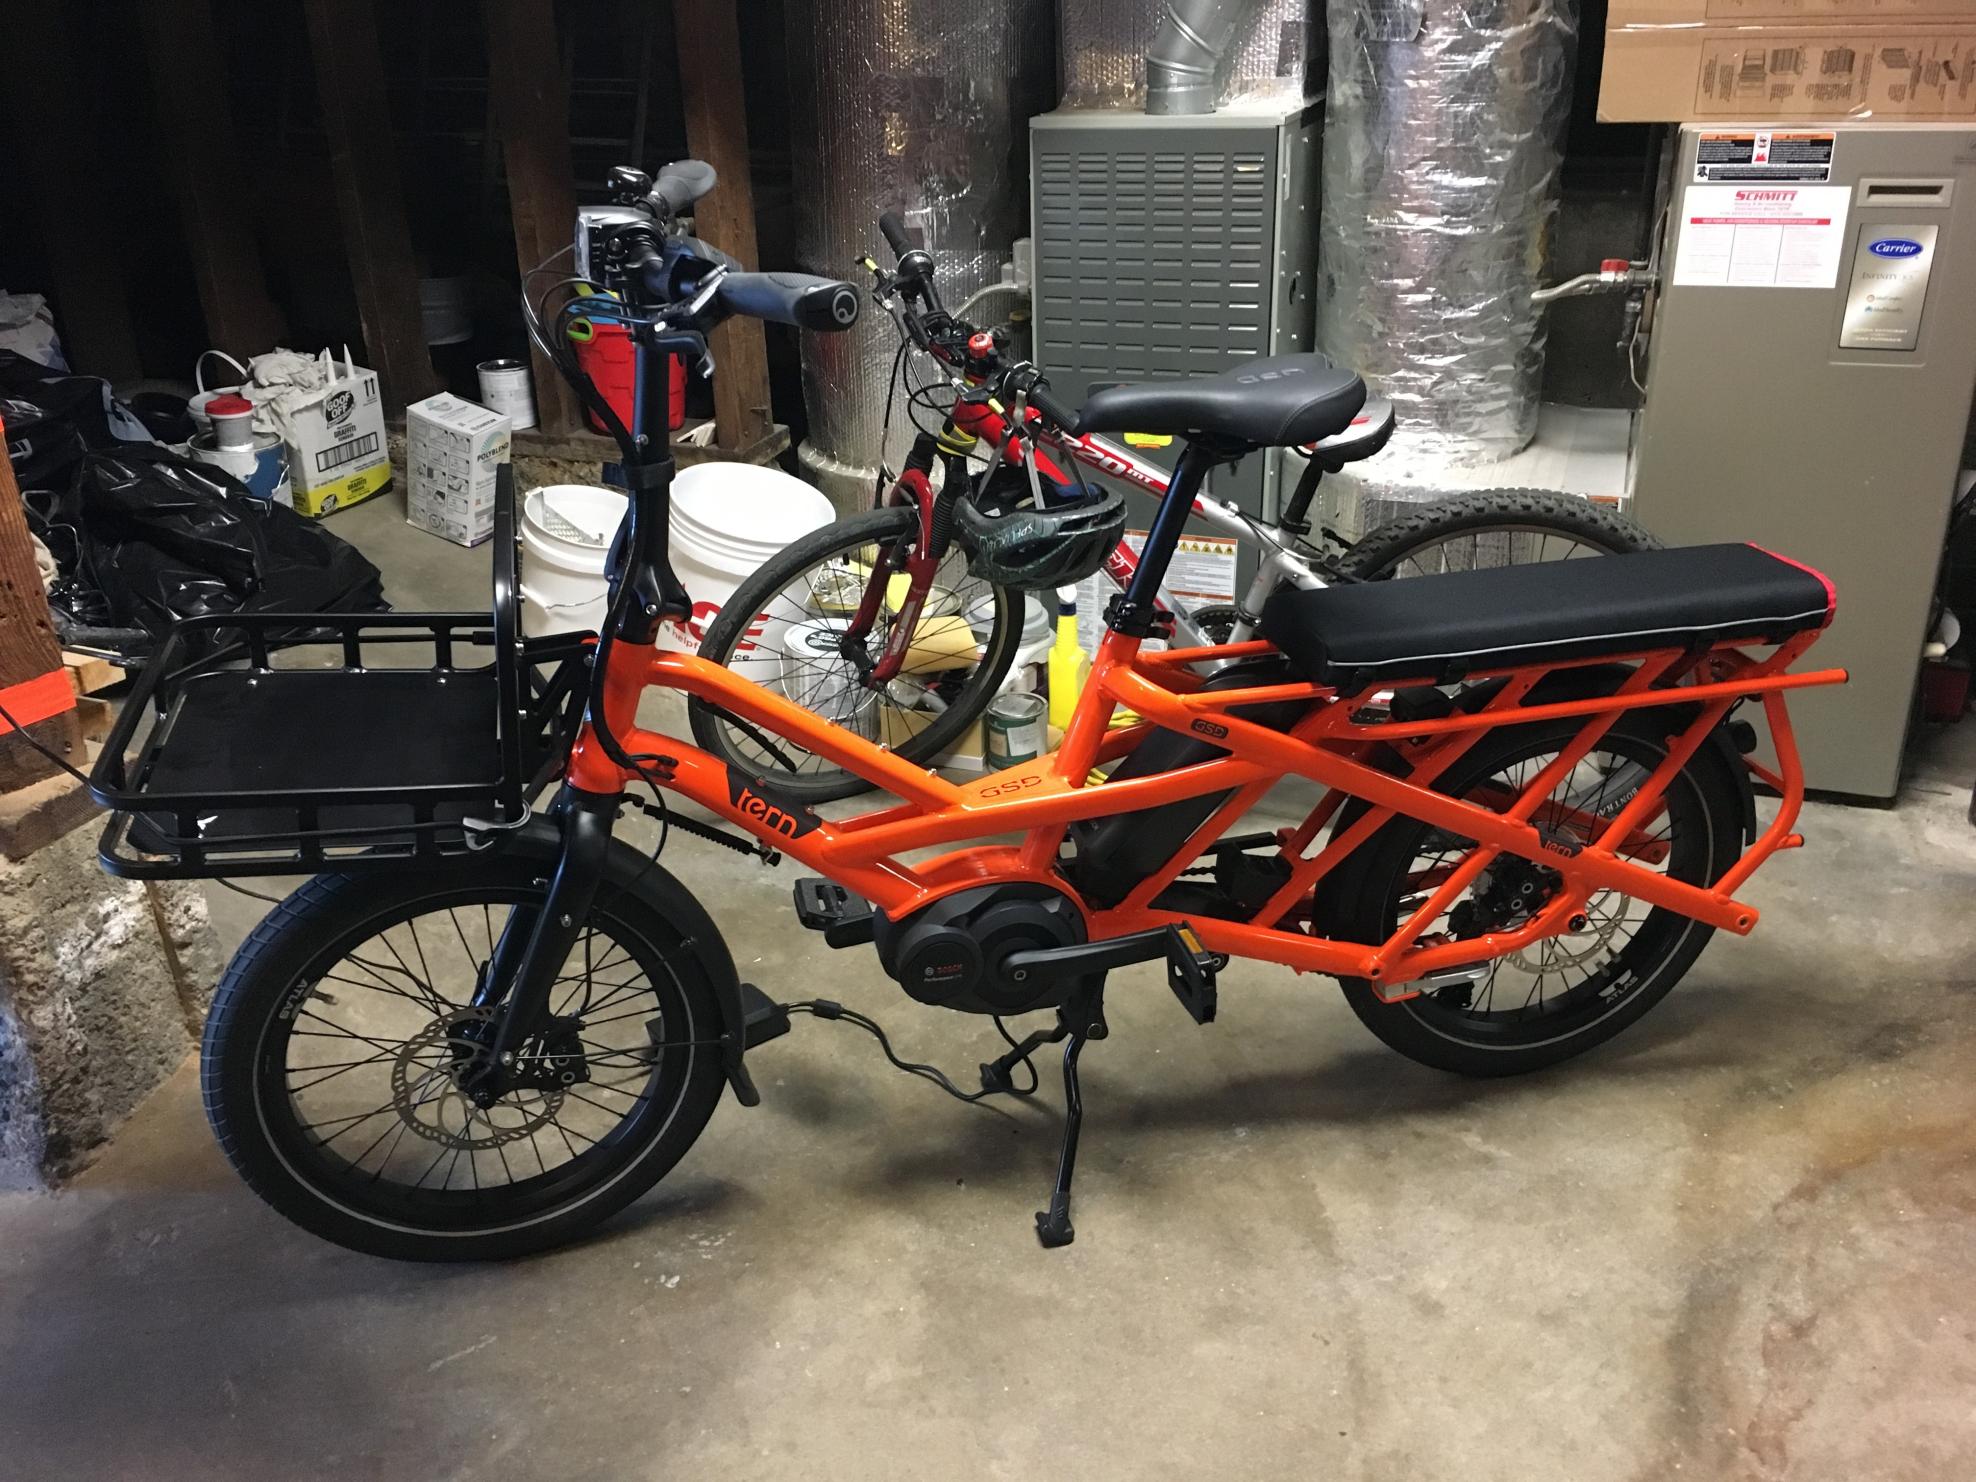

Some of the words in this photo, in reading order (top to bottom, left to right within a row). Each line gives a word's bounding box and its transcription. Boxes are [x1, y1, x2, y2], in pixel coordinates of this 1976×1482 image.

[1735, 190, 1798, 201] SCHMITT
[1875, 242, 1917, 253] Carrier
[327, 391, 351, 411] GOOF
[331, 403, 348, 418] OFF
[477, 441, 509, 461] POLYBLEND
[671, 630, 699, 648] helpf
[1194, 720, 1225, 737] GSD
[980, 776, 1042, 797] GSD
[737, 787, 798, 838] tern
[278, 978, 308, 1019] ATLAS
[1606, 975, 1639, 1004] ATLAS
